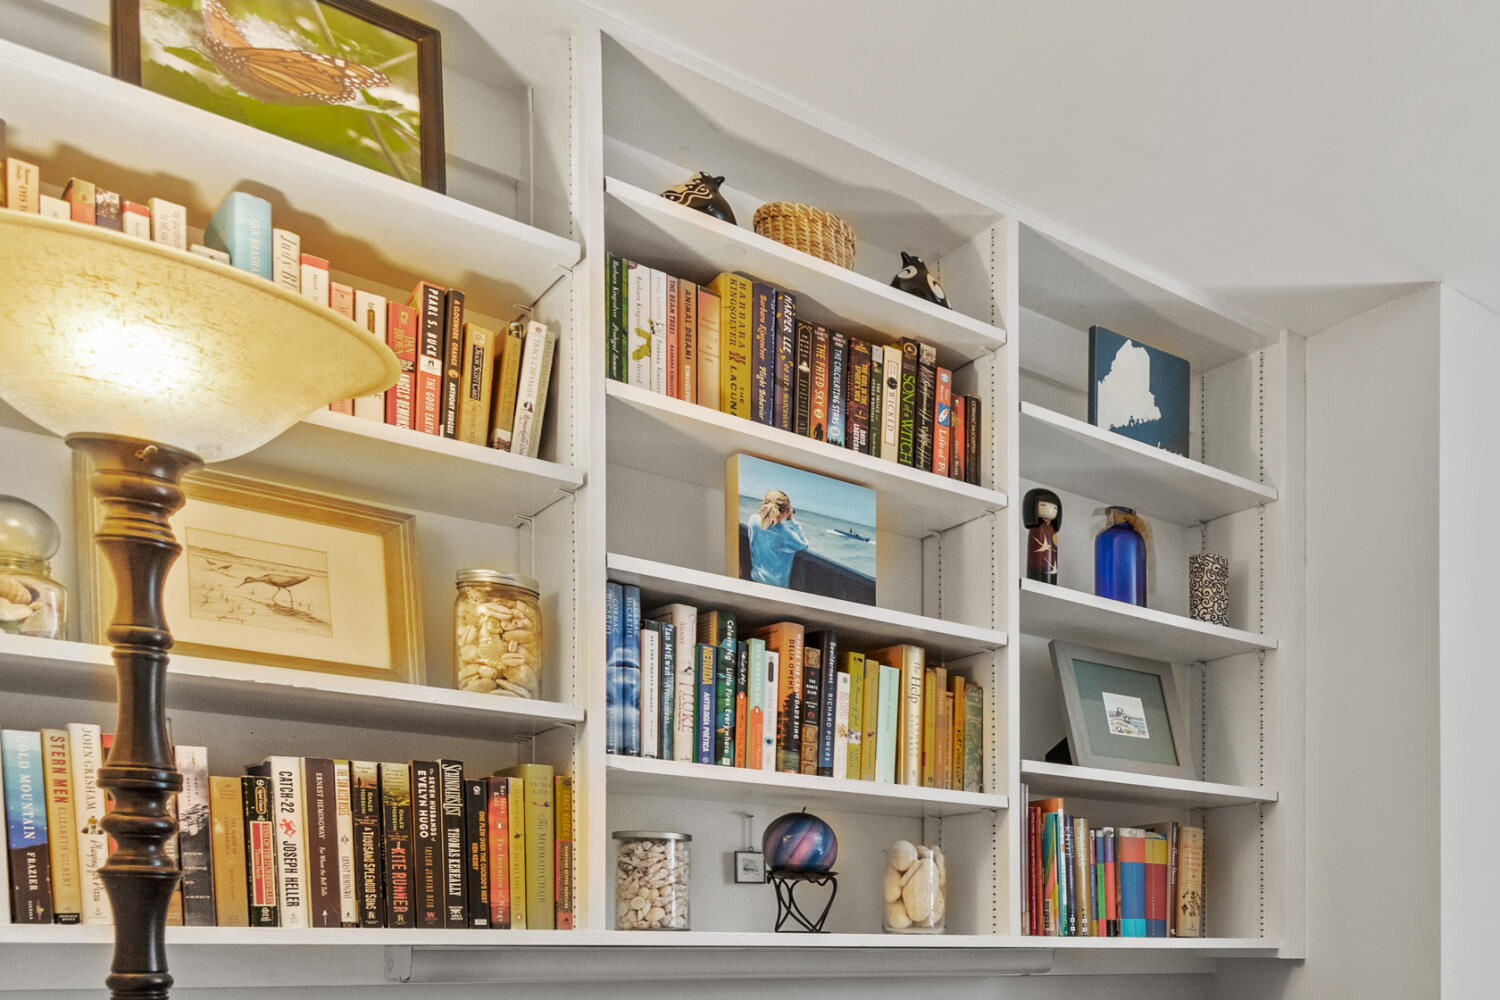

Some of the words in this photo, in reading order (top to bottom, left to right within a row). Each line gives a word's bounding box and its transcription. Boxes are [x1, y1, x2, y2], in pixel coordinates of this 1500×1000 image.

[427, 288, 440, 317] PEARL
[684, 289, 692, 325] ANIMAL
[729, 278, 738, 347] KINGSOLVER
[739, 282, 747, 349] BARBARA
[783, 294, 793, 334] HARPER
[425, 333, 439, 357] BUCK
[450, 342, 460, 366] ORANGE
[782, 335, 792, 354] LEE
[816, 342, 826, 360] THE
[426, 377, 437, 392] THE
[815, 360, 826, 388] FATED
[902, 373, 916, 405] SON
[424, 393, 435, 412] GOOD
[448, 382, 458, 410] ANTHONY
[814, 388, 825, 407] SKY
[899, 418, 914, 465] WITCH
[938, 427, 947, 448] Life
[937, 460, 946, 472] Pi
[726, 619, 735, 648] Celeste
[702, 645, 714, 685] NERUDA
[724, 649, 735, 662] Ng
[828, 641, 837, 684] Bewilderment
[725, 667, 734, 687] Little
[787, 664, 795, 690] OWENS
[907, 675, 921, 704] Help
[724, 688, 733, 707] Fires
[825, 692, 834, 728] RICHARD
[722, 708, 733, 755] Everywhere
[792, 721, 800, 740] SING
[50, 735, 67, 774] STERN
[823, 730, 832, 762] POWERS
[52, 778, 69, 804] MEN
[83, 760, 97, 811] GRISHAM
[279, 771, 295, 813] CATCH-22
[315, 772, 324, 798] ERNEST
[417, 770, 429, 808] EVELYN
[428, 776, 437, 799] SEVEN
[19, 774, 36, 840] MOUNTAIN
[316, 799, 326, 840] HEMINGWAY
[429, 800, 438, 837] HUSBANDS
[419, 809, 429, 839] HUGO
[283, 840, 298, 874] JOSEPH
[362, 831, 375, 863] THOUSAND
[447, 828, 461, 859] THOMAS
[26, 851, 38, 892] FRAZIER
[391, 847, 407, 871] KITE
[285, 877, 300, 908] HELLER
[363, 863, 376, 893] SPLENDID
[391, 872, 409, 913] RUNNER
[448, 858, 462, 897] KENEALLY
[365, 894, 377, 910] SUNS
